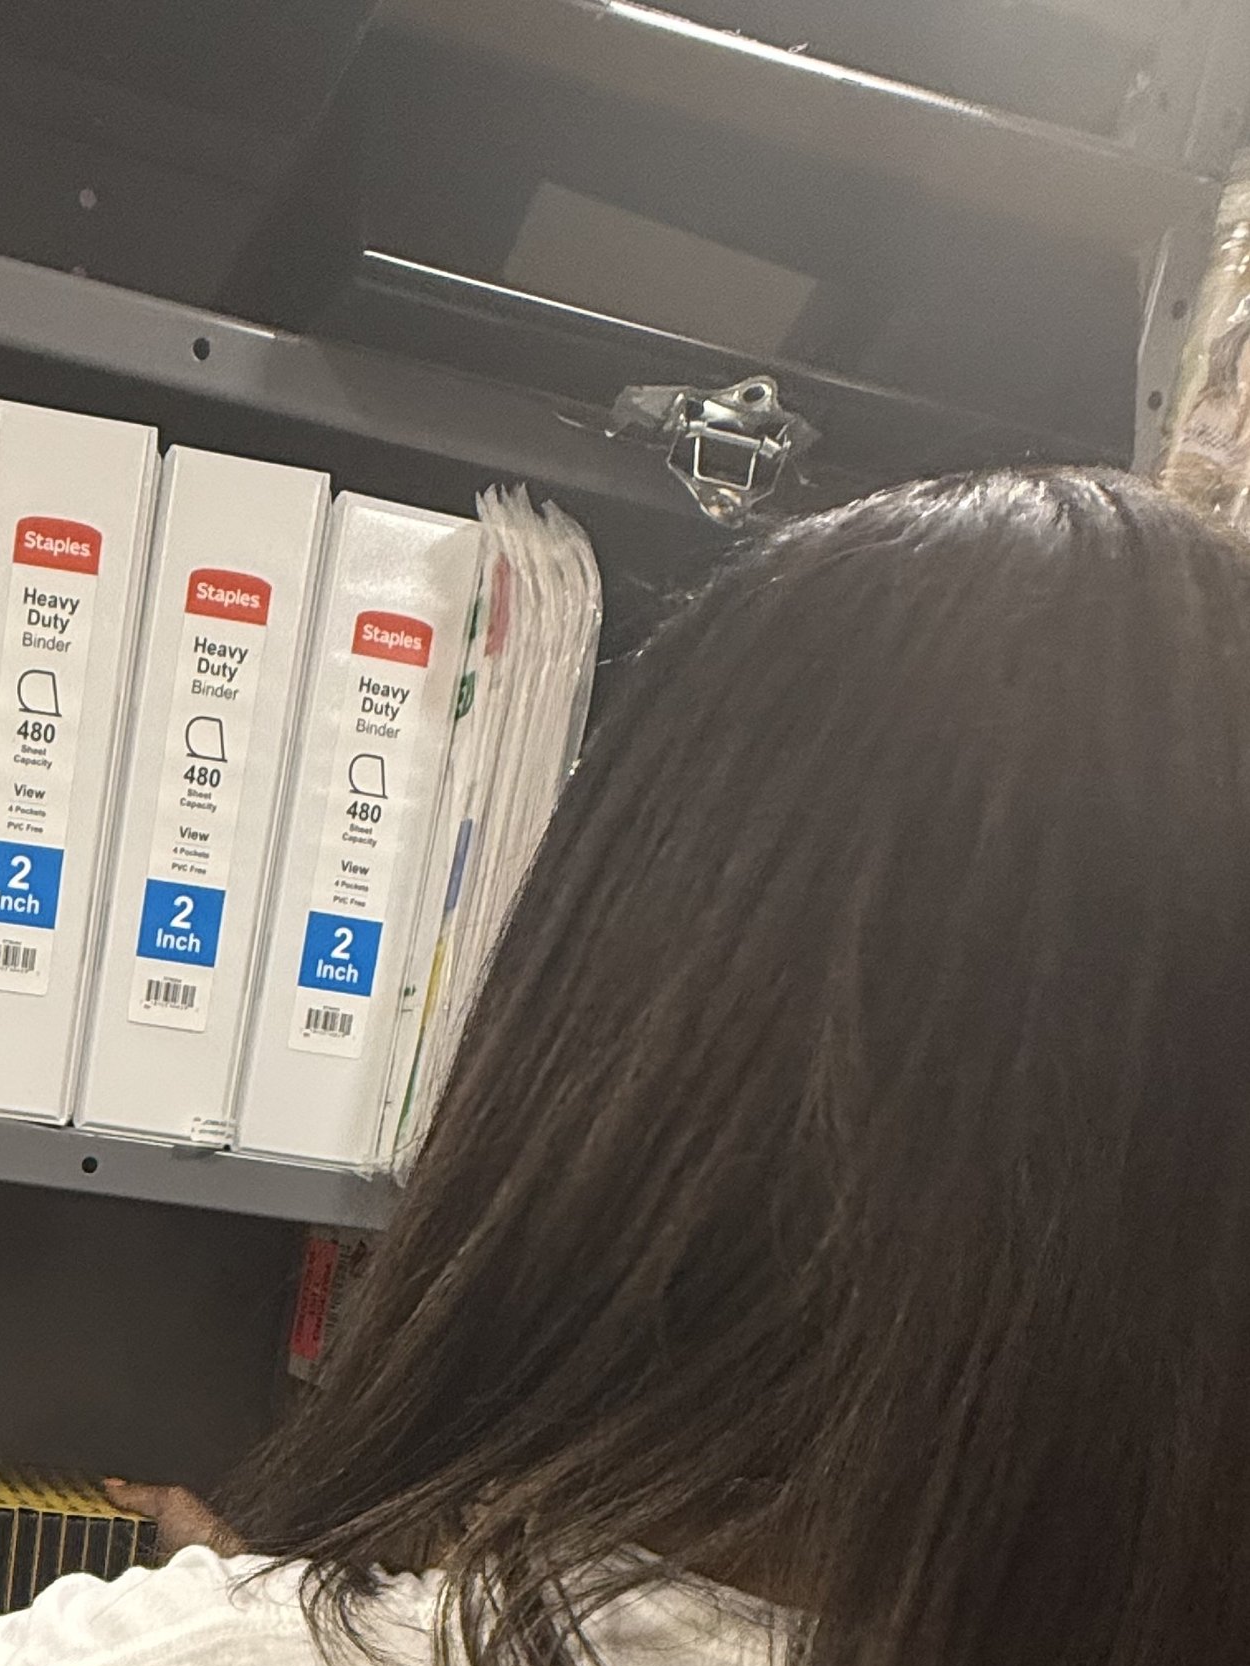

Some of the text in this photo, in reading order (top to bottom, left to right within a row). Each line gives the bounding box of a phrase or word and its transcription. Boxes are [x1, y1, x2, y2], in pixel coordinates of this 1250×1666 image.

[24, 531, 91, 557] Staples
[23, 587, 79, 616] Heavy
[196, 582, 261, 609] Staples
[27, 609, 70, 635] Duty
[22, 632, 71, 653] Binder
[362, 623, 422, 650] Staples
[194, 636, 248, 664] Heavy
[197, 657, 238, 683] Duty
[191, 679, 239, 700] Binder
[359, 676, 409, 704] Heavy
[361, 697, 399, 722] Duty
[17, 720, 55, 743] 480
[356, 718, 401, 739] Binder
[184, 765, 221, 788] 480
[14, 783, 46, 800] View
[346, 800, 381, 823] 480
[179, 826, 209, 842] View
[7, 855, 32, 891] 2
[341, 860, 369, 876] View
[170, 895, 194, 930] 2
[156, 928, 201, 953] Inch
[331, 927, 353, 960] 2
[316, 959, 358, 983] Inch
